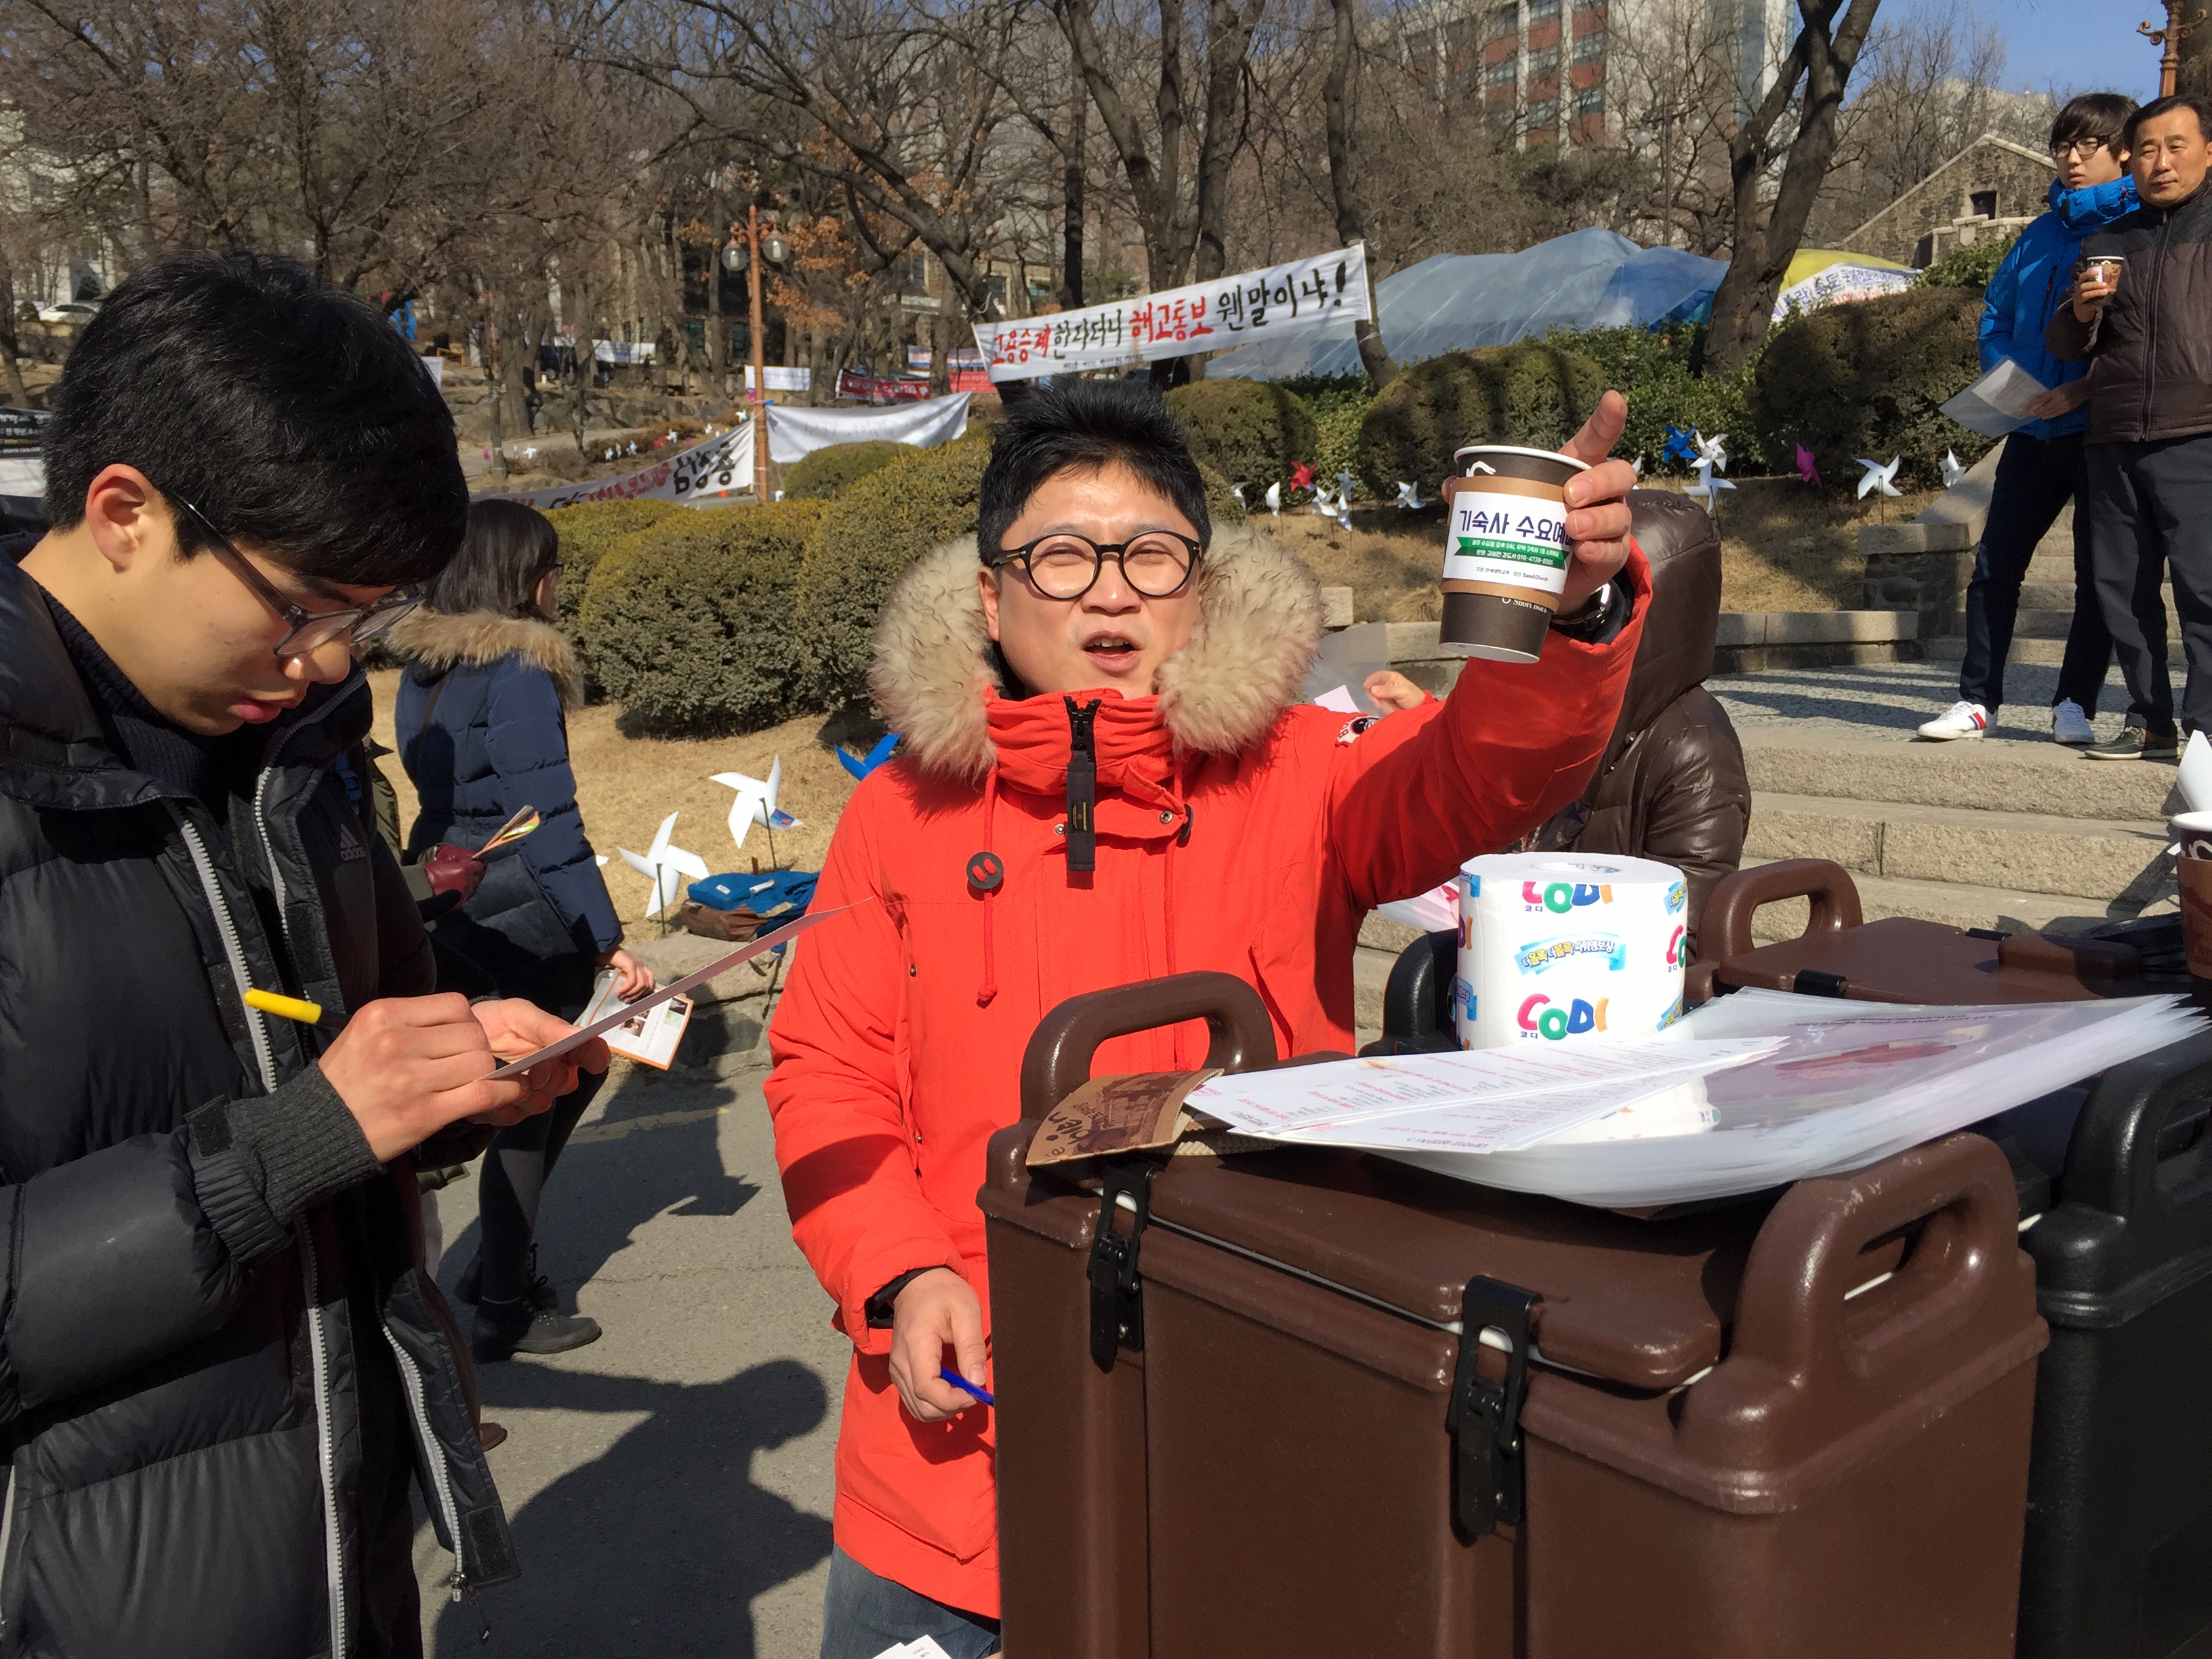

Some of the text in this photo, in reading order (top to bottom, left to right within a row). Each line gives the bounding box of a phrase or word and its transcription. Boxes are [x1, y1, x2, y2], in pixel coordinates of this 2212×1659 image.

[1053, 309, 1122, 359] 한다더니
[1128, 296, 1214, 344] 해고통보
[1460, 510, 1509, 534] 기숙사
[340, 845, 365, 861] adidas
[1521, 881, 1614, 914] CODI
[1524, 905, 1543, 913] 코디
[1517, 993, 1610, 1041] CODI
[1519, 1031, 1538, 1039] 코디
